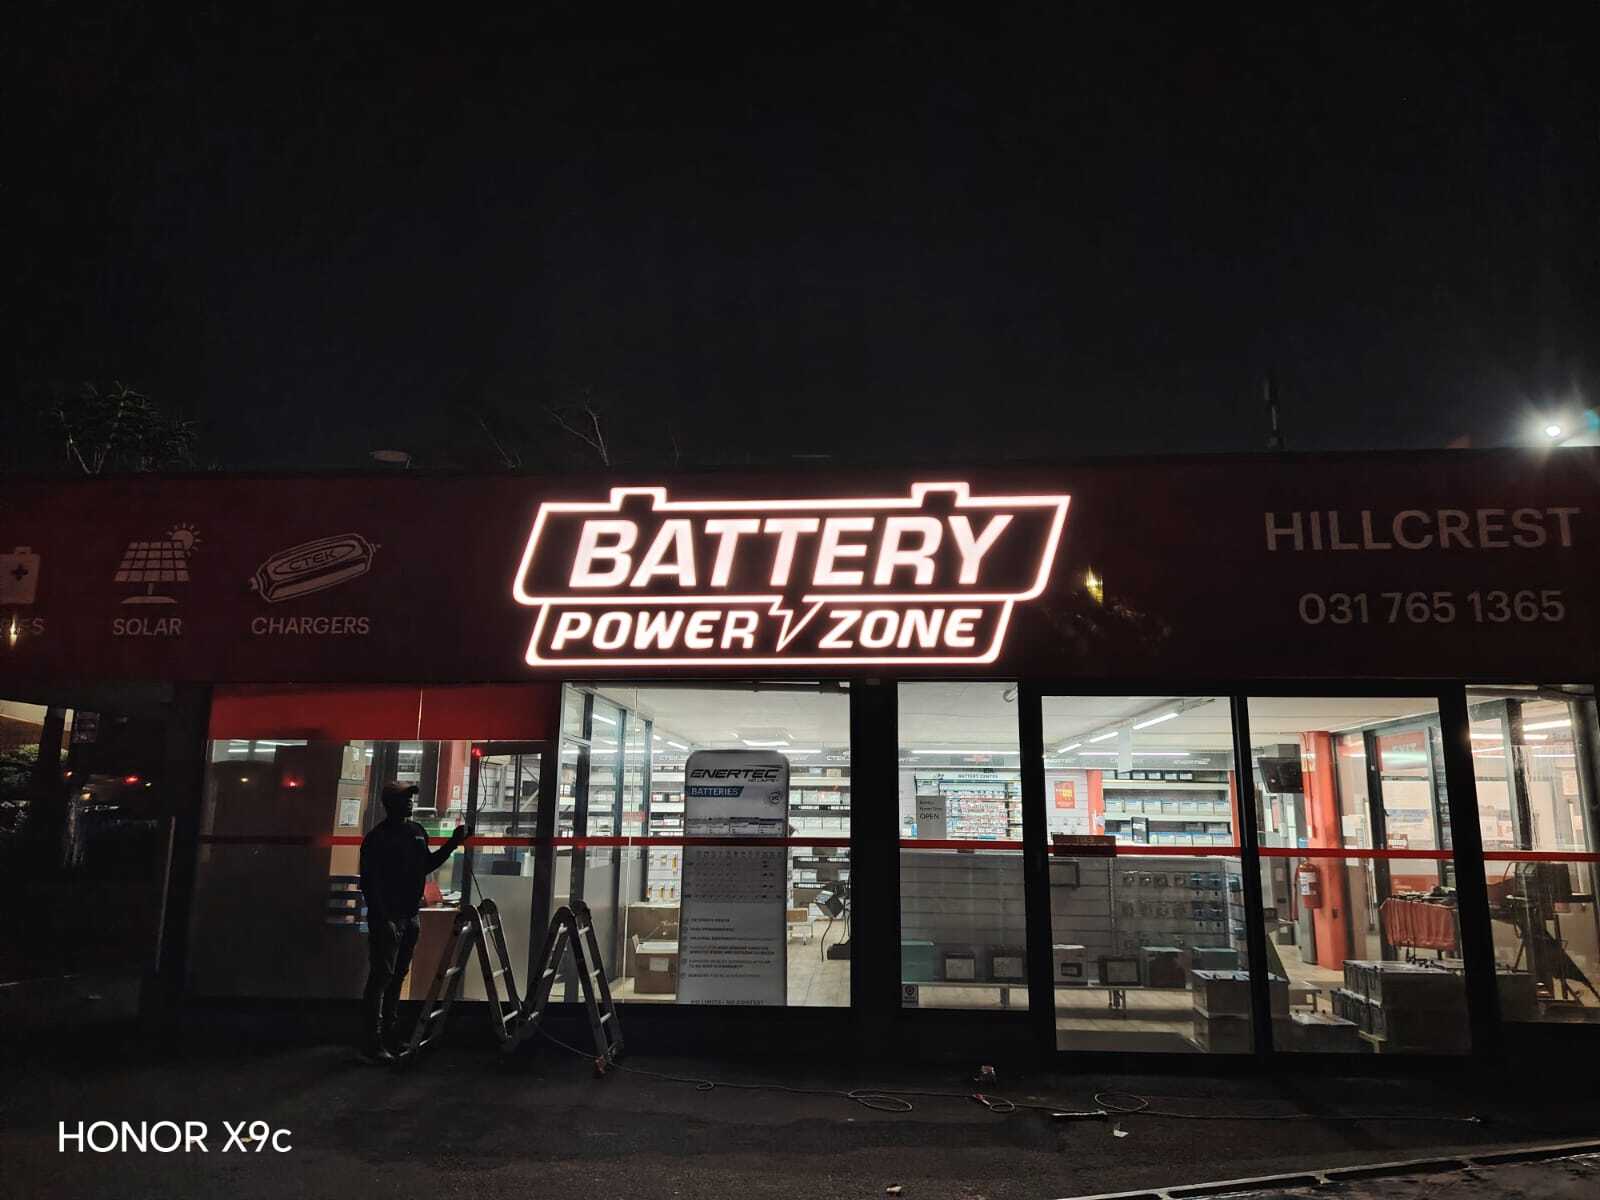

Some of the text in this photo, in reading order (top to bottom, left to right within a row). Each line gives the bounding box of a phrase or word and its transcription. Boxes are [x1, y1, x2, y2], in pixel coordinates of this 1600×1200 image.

[1264, 507, 1581, 551] HILLCREST
[289, 549, 336, 571] CTEK
[568, 514, 1013, 588] BATTERY
[1299, 589, 1566, 625] 031 765 1365
[112, 616, 183, 636] SOLAR
[251, 616, 370, 635] CHARGERS
[551, 608, 984, 649] POWER ZONE
[690, 768, 780, 779] ENERTEC
[691, 787, 739, 797] BATTERIES
[919, 812, 940, 820] OPEN
